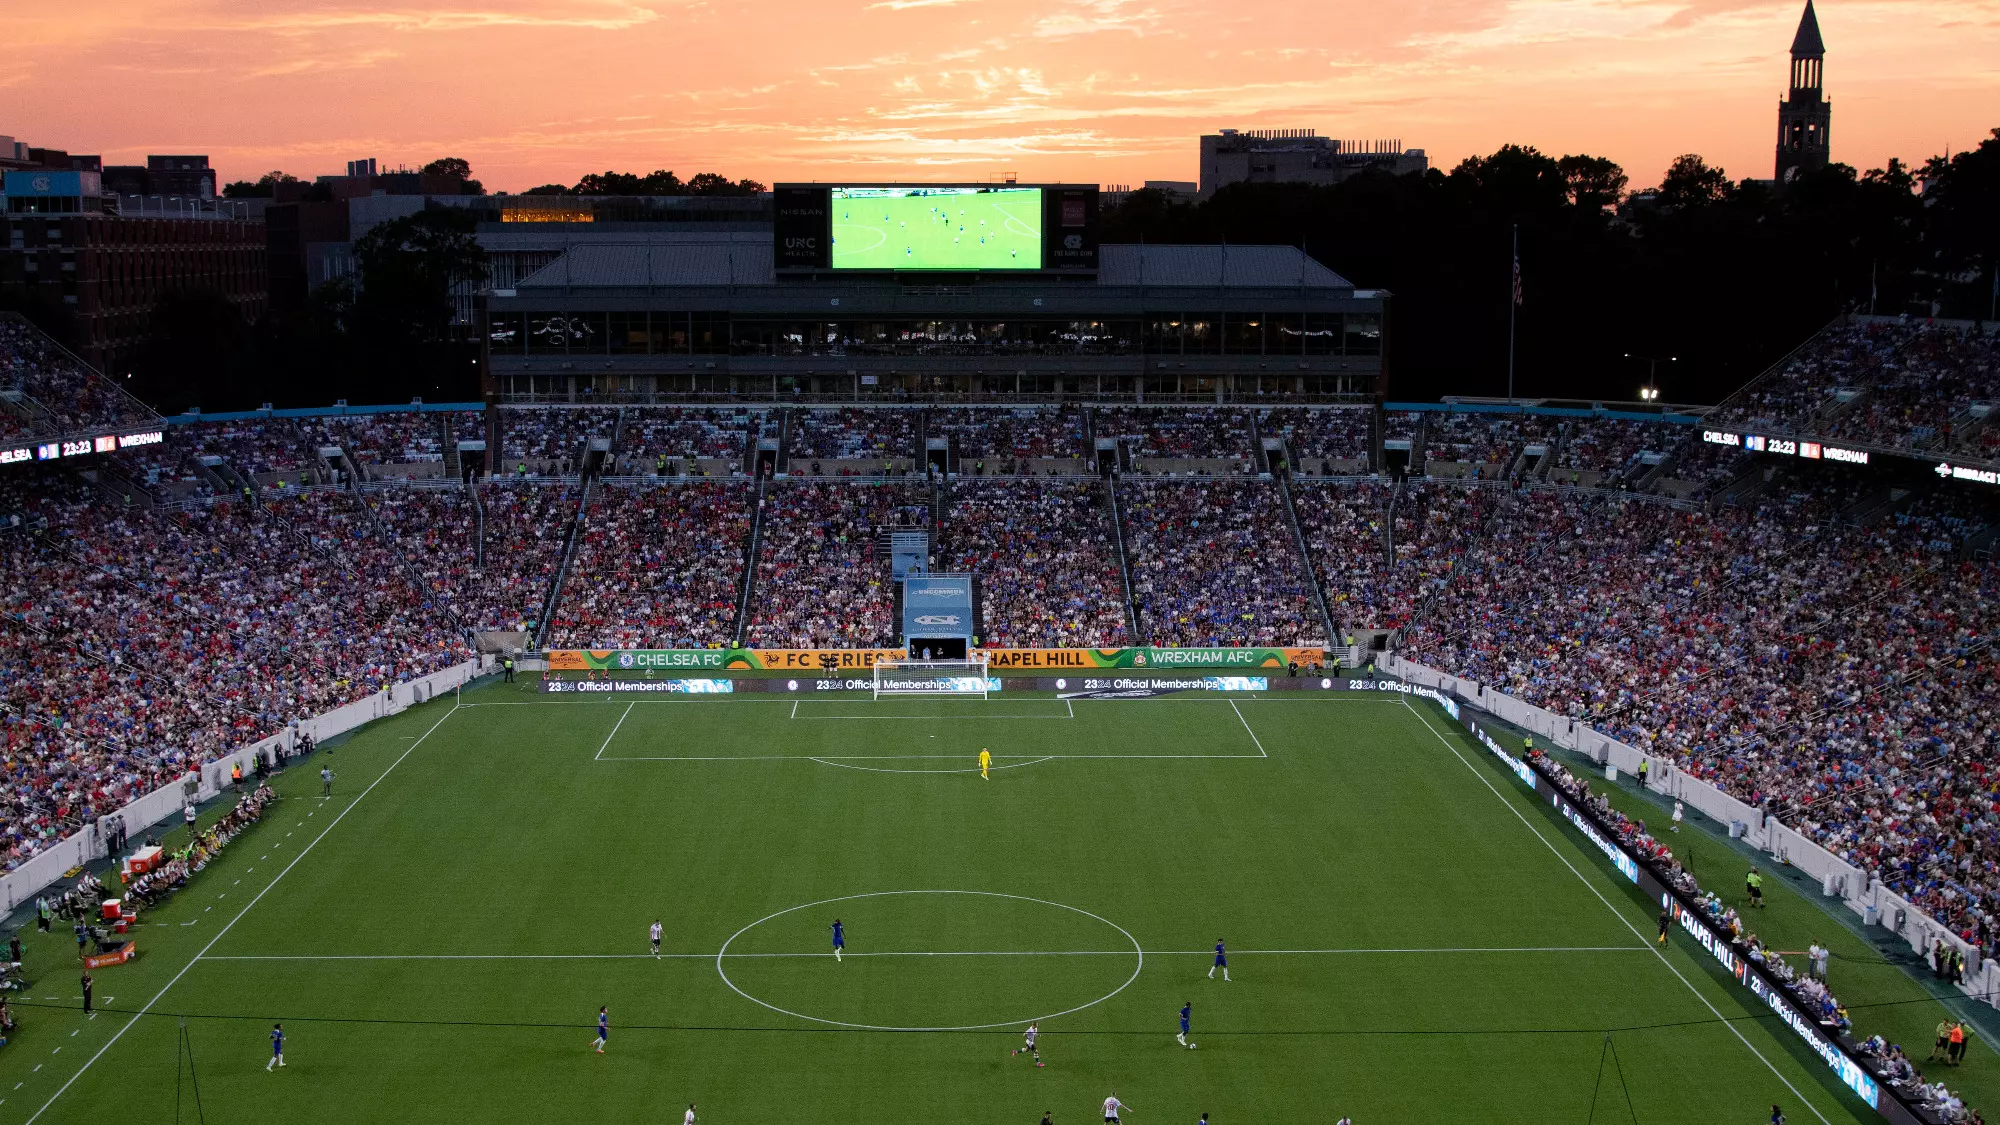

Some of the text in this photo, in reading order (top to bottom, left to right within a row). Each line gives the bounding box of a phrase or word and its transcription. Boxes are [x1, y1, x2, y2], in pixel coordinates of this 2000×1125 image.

[780, 208, 823, 216] NISSAN
[785, 237, 816, 249] UNC
[118, 431, 163, 448] WREXHAM
[1703, 430, 1739, 446] CHELSEA
[63, 440, 92, 456] 23:23
[1768, 439, 1796, 455] 23:23
[1822, 447, 1869, 464] WREXHAM
[637, 654, 721, 666] CHELSEA FC
[787, 653, 810, 667] FC
[1047, 653, 1085, 666] HILL
[1151, 652, 1254, 663] WREXHAM AFC
[577, 681, 612, 692] Official
[615, 681, 682, 694] Memberships
[845, 680, 881, 690] Official
[883, 679, 951, 692] Memberships
[1114, 679, 1148, 689] Official
[1151, 679, 1218, 691] Memberships
[1378, 681, 1412, 694] Official
[1680, 909, 1734, 972] CHAPEL HILL
[1768, 992, 1793, 1024] Official
[1792, 1013, 1840, 1070] Memberships
